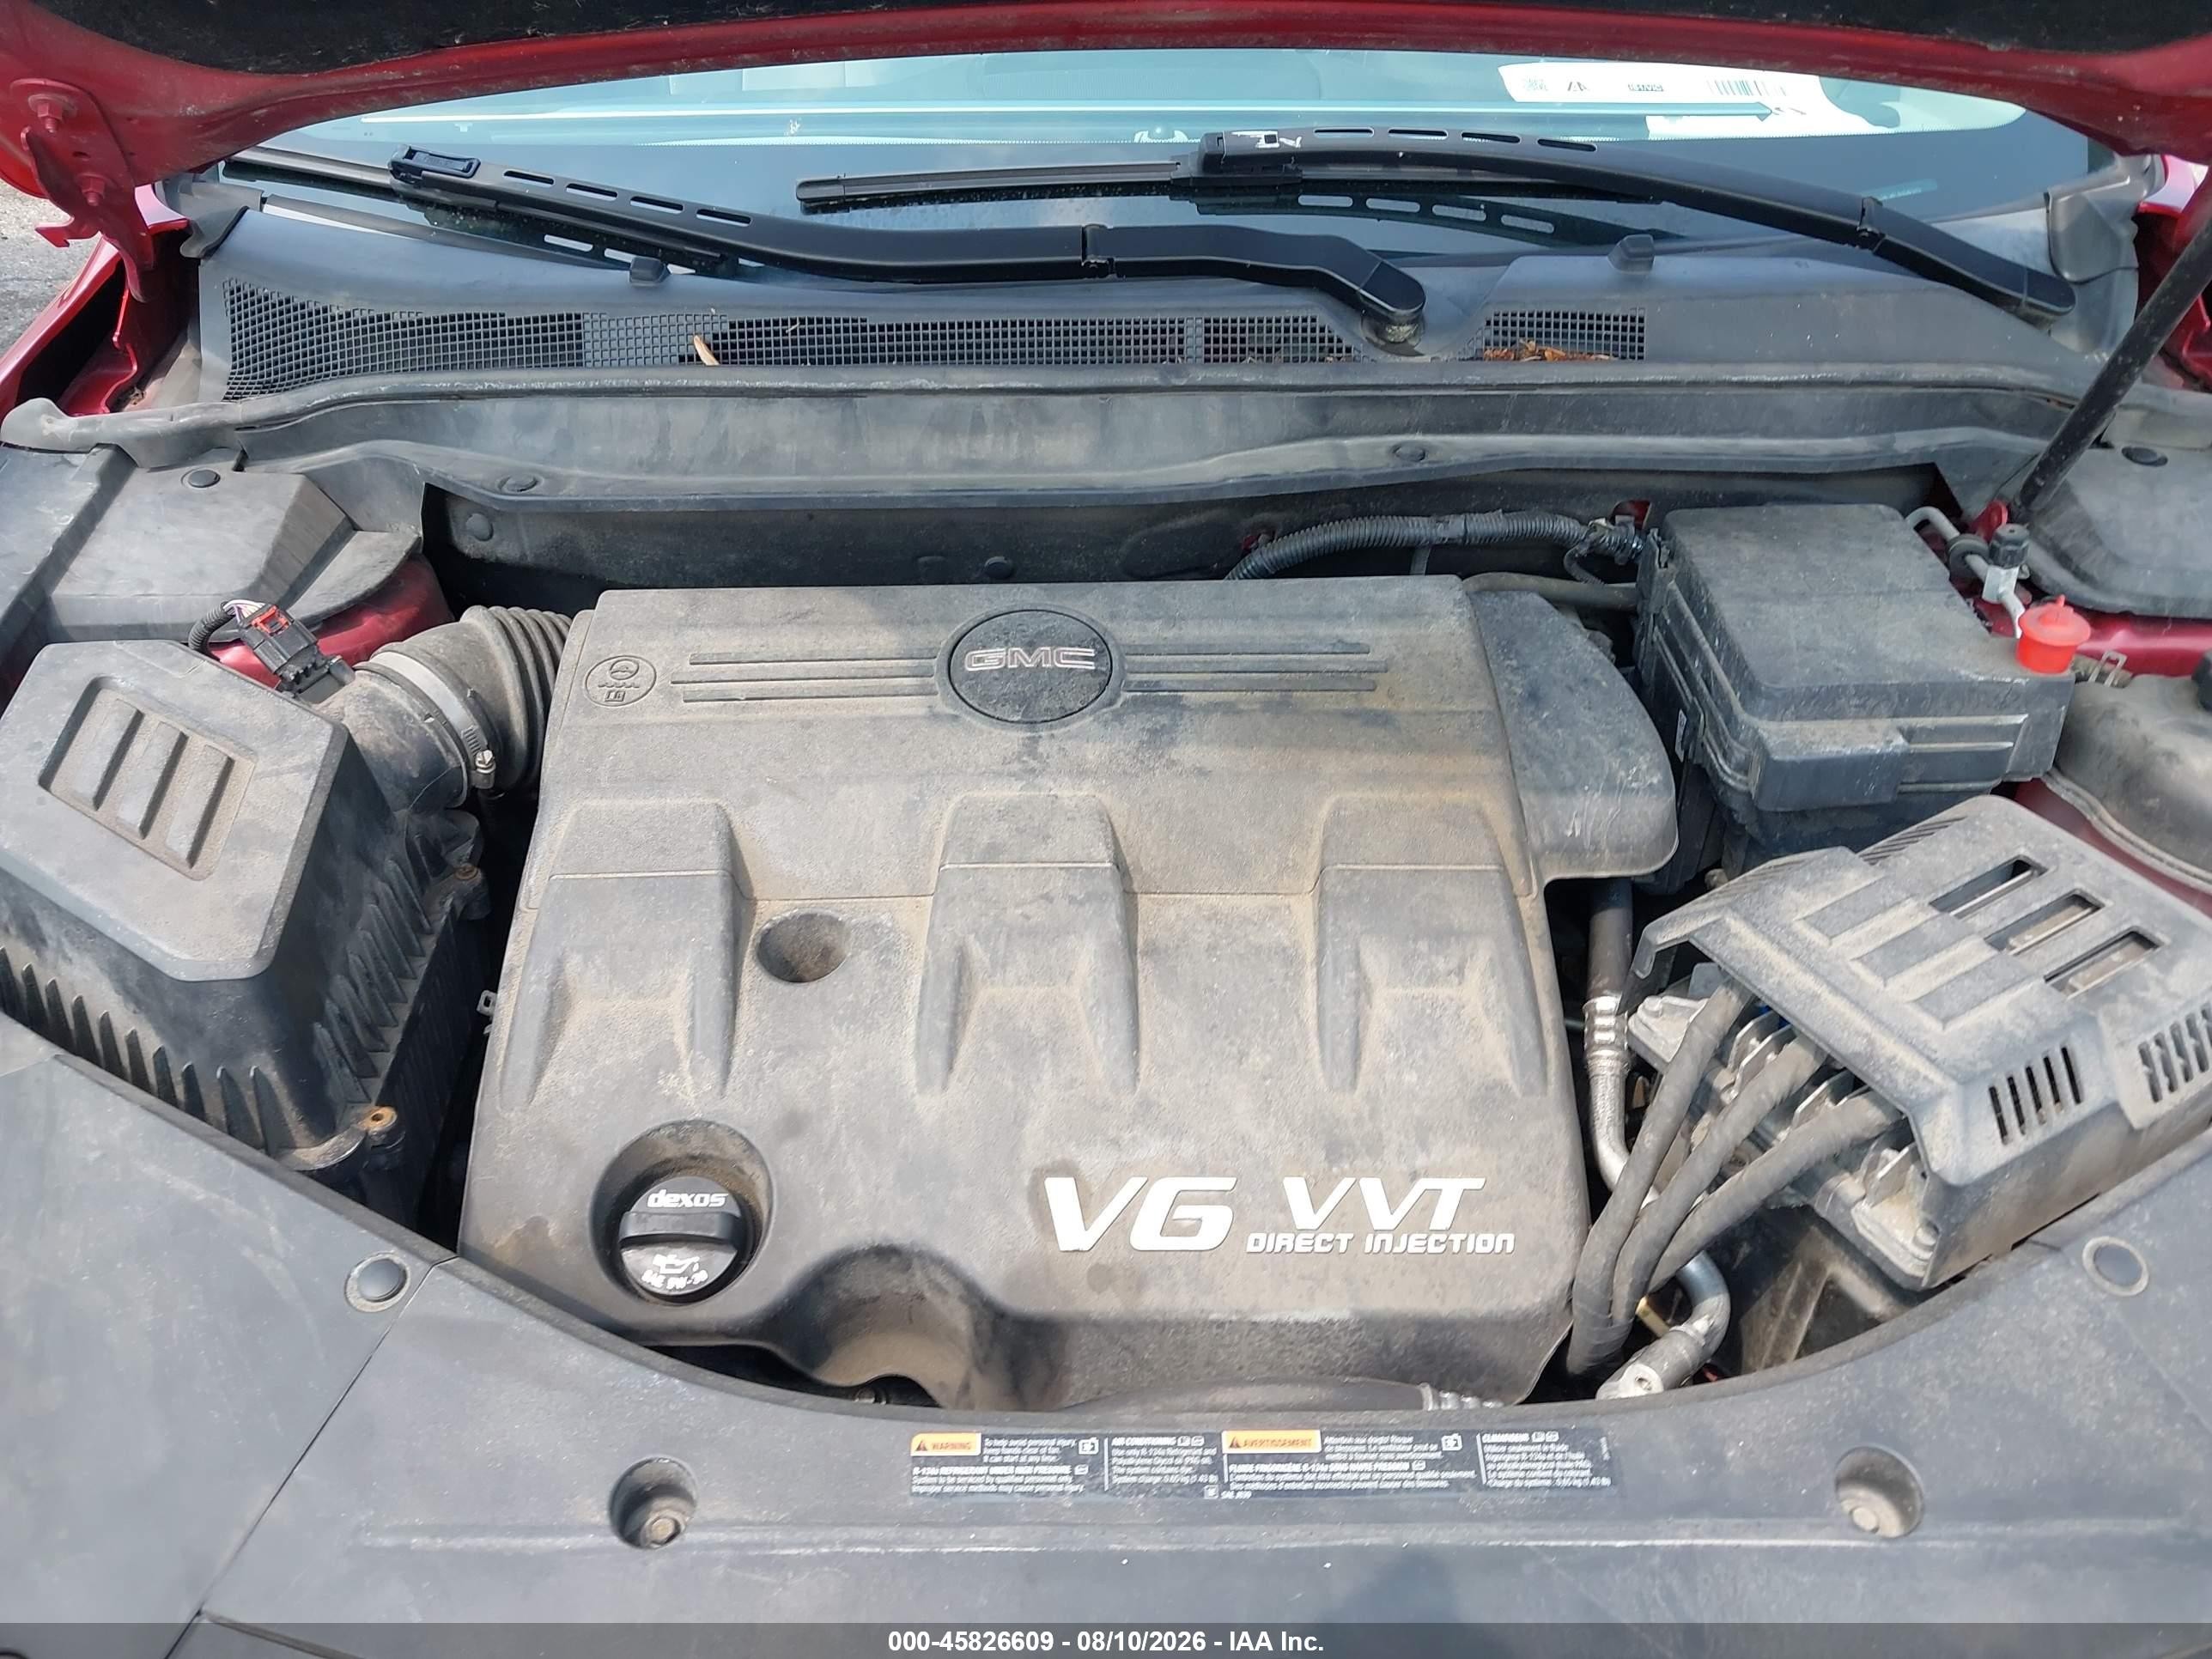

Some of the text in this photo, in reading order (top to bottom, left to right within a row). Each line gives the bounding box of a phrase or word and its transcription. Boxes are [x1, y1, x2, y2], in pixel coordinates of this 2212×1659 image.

[964, 646, 1096, 672] GMC
[647, 1188, 729, 1208] dexos
[1043, 1176, 1487, 1253] V6 VVT
[1246, 1232, 1516, 1254] DIRECT INJECTION
[932, 1442, 973, 1450] WARNING
